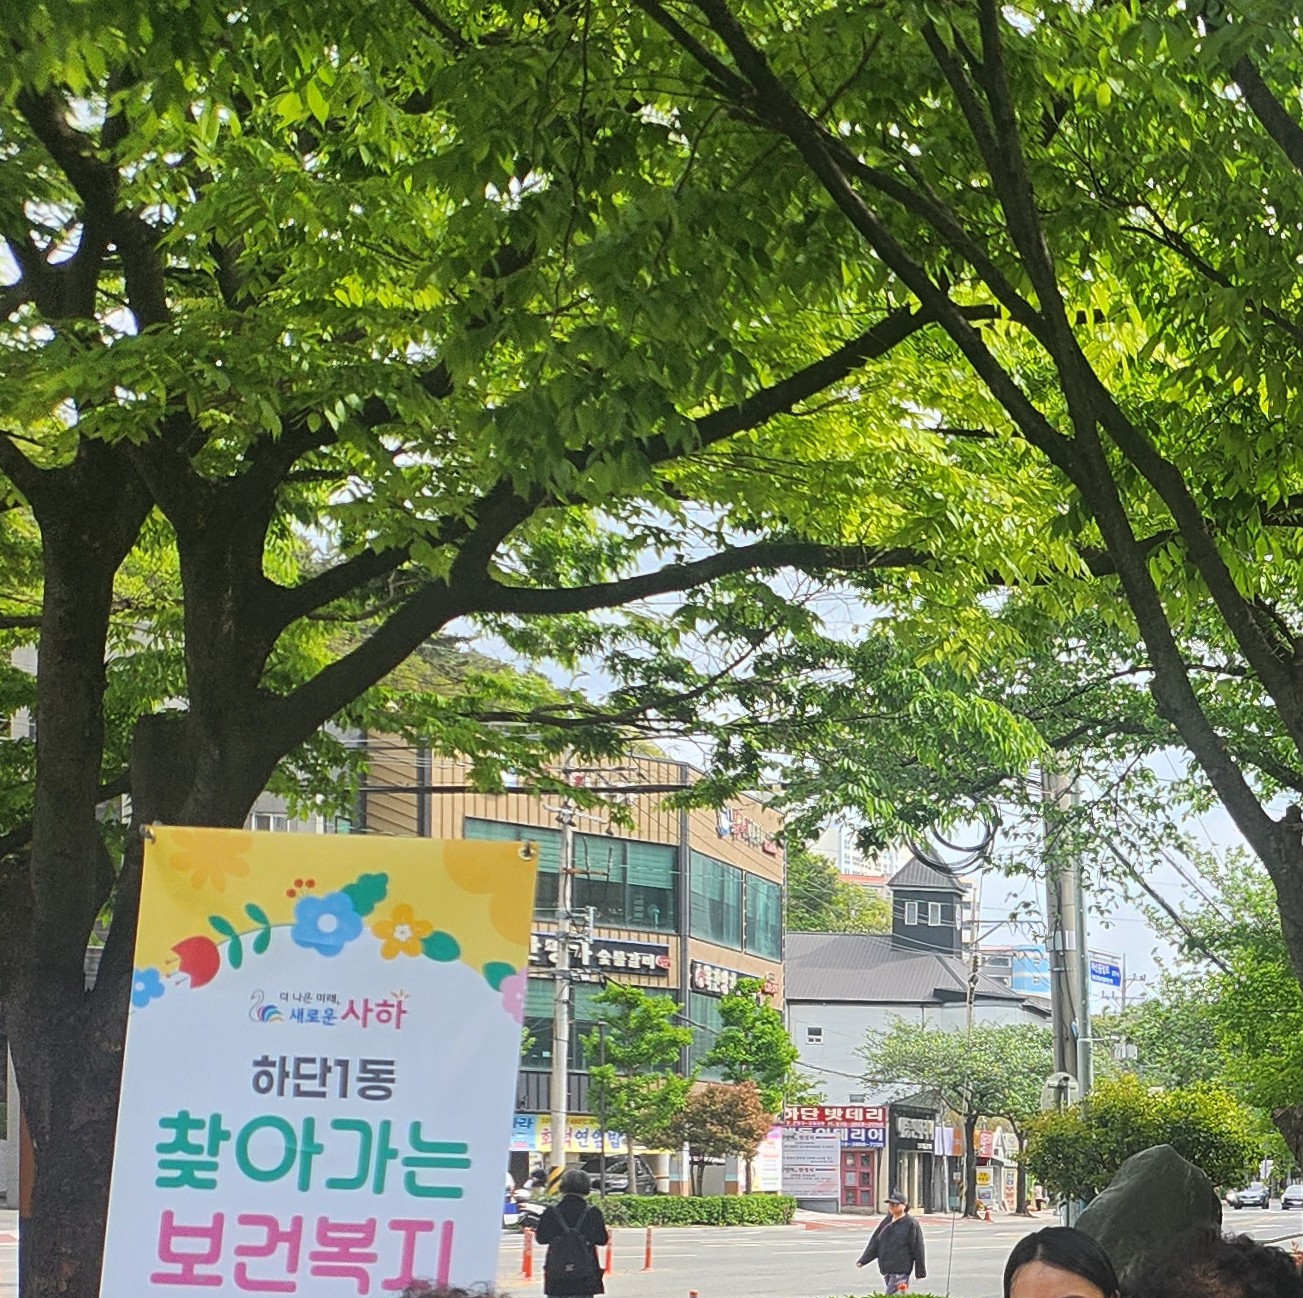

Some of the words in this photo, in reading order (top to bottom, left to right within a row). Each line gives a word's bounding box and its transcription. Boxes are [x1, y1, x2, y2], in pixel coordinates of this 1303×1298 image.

[279, 991, 289, 1001] 더
[292, 992, 313, 1004] 나은
[316, 992, 341, 1006] 미래,
[289, 1007, 338, 1026] 새로운
[341, 998, 408, 1030] 사하
[252, 1055, 396, 1101] 하단1동
[784, 1107, 820, 1121] 하단
[824, 1107, 883, 1122] 밧데리
[155, 1110, 472, 1199] 찾아가는
[150, 1210, 454, 1295] 보건복지
